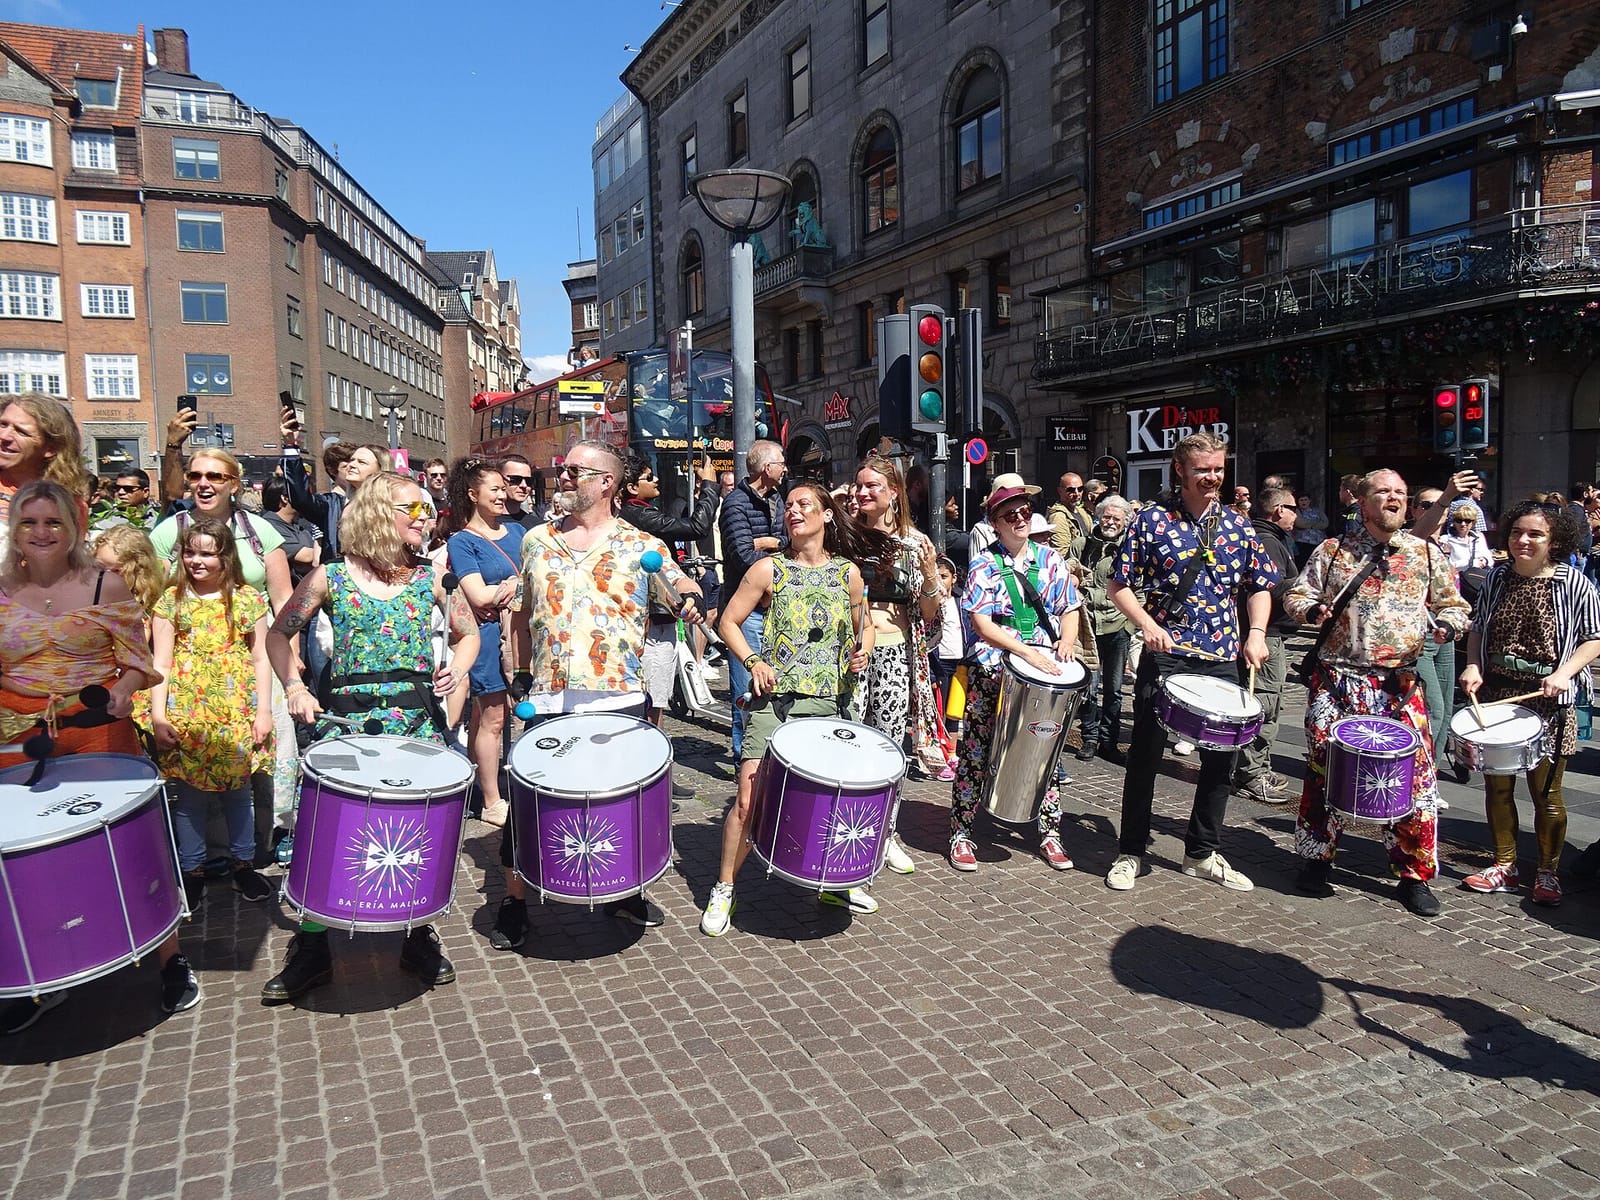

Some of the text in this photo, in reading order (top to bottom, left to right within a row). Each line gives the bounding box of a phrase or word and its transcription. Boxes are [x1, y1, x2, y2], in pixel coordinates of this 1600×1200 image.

[1070, 234, 1463, 360] PIZZA FRANKIES
[93, 409, 121, 417] AMNESTY
[824, 391, 850, 422] MAX
[1465, 406, 1483, 420] 20
[1054, 426, 1087, 441] KEBAB
[552, 735, 581, 758] TIMBRA
[37, 793, 96, 817] TIMBRA
[811, 863, 847, 873] BAERÍA
[550, 877, 587, 888] BATERÍA
